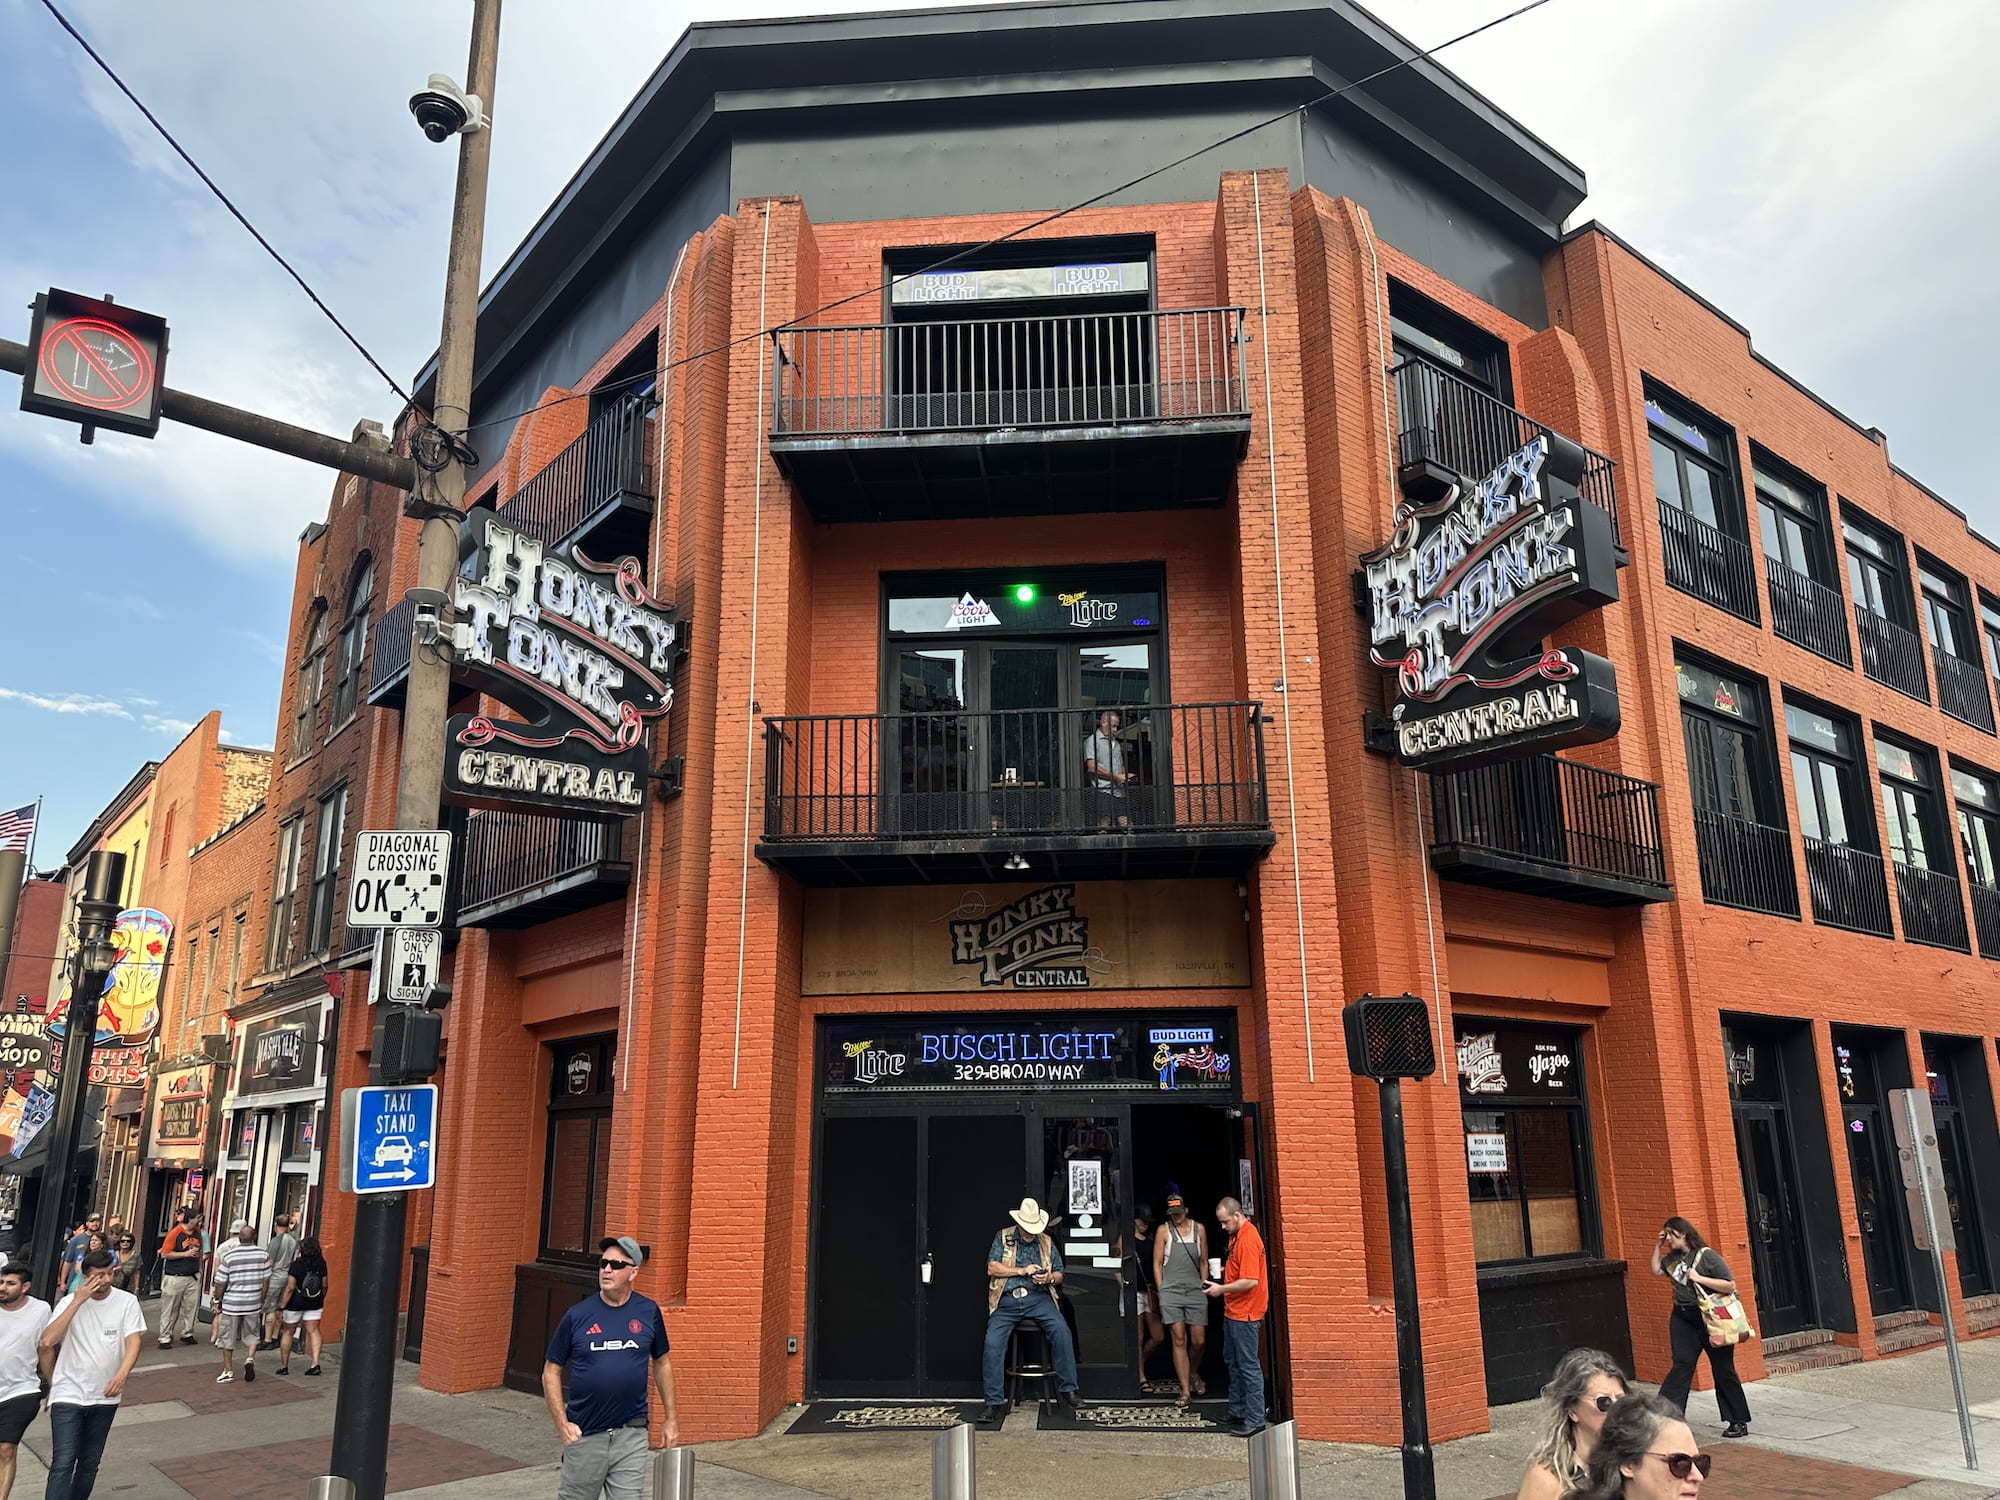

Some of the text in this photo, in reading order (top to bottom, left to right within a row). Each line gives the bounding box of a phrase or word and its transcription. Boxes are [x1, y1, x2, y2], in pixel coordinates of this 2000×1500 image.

[922, 275, 966, 288] BUD
[1065, 267, 1109, 282] BUD
[915, 287, 975, 300] LIGHT
[1057, 282, 1118, 294] LIGHT
[1366, 434, 1548, 646] HONKY
[481, 519, 676, 673] HONKY
[1405, 507, 1576, 691] TONK
[951, 602, 990, 616] Coors
[957, 615, 986, 624] LIGHT
[1070, 600, 1117, 627] Lite
[455, 577, 624, 725] TONK
[1400, 683, 1578, 757] CENTRAL
[458, 748, 642, 805] CENTRAL
[369, 835, 440, 853] DIAGONAL
[368, 854, 438, 872] CROSSING
[355, 879, 391, 912] OK
[954, 887, 1071, 960] HONKY
[401, 931, 434, 943] CROSS
[403, 942, 430, 954] ONLY
[409, 953, 423, 964] ON
[976, 921, 1084, 982] TONK
[1016, 969, 1088, 986] CENTRAL
[396, 987, 423, 999] SIGNA
[1152, 1031, 1210, 1040] BUD LIGHT
[921, 1033, 1116, 1063] BUSCH LIGHT
[1456, 1034, 1496, 1072] HONKY
[854, 1051, 906, 1084] Lite
[954, 1063, 1084, 1081] 329 BROADWAY
[1464, 1054, 1502, 1090] TONK
[1529, 1055, 1570, 1083] Yazoo
[384, 1092, 412, 1113] TAXI
[376, 1113, 416, 1134] STAND
[589, 1339, 640, 1351] USA
